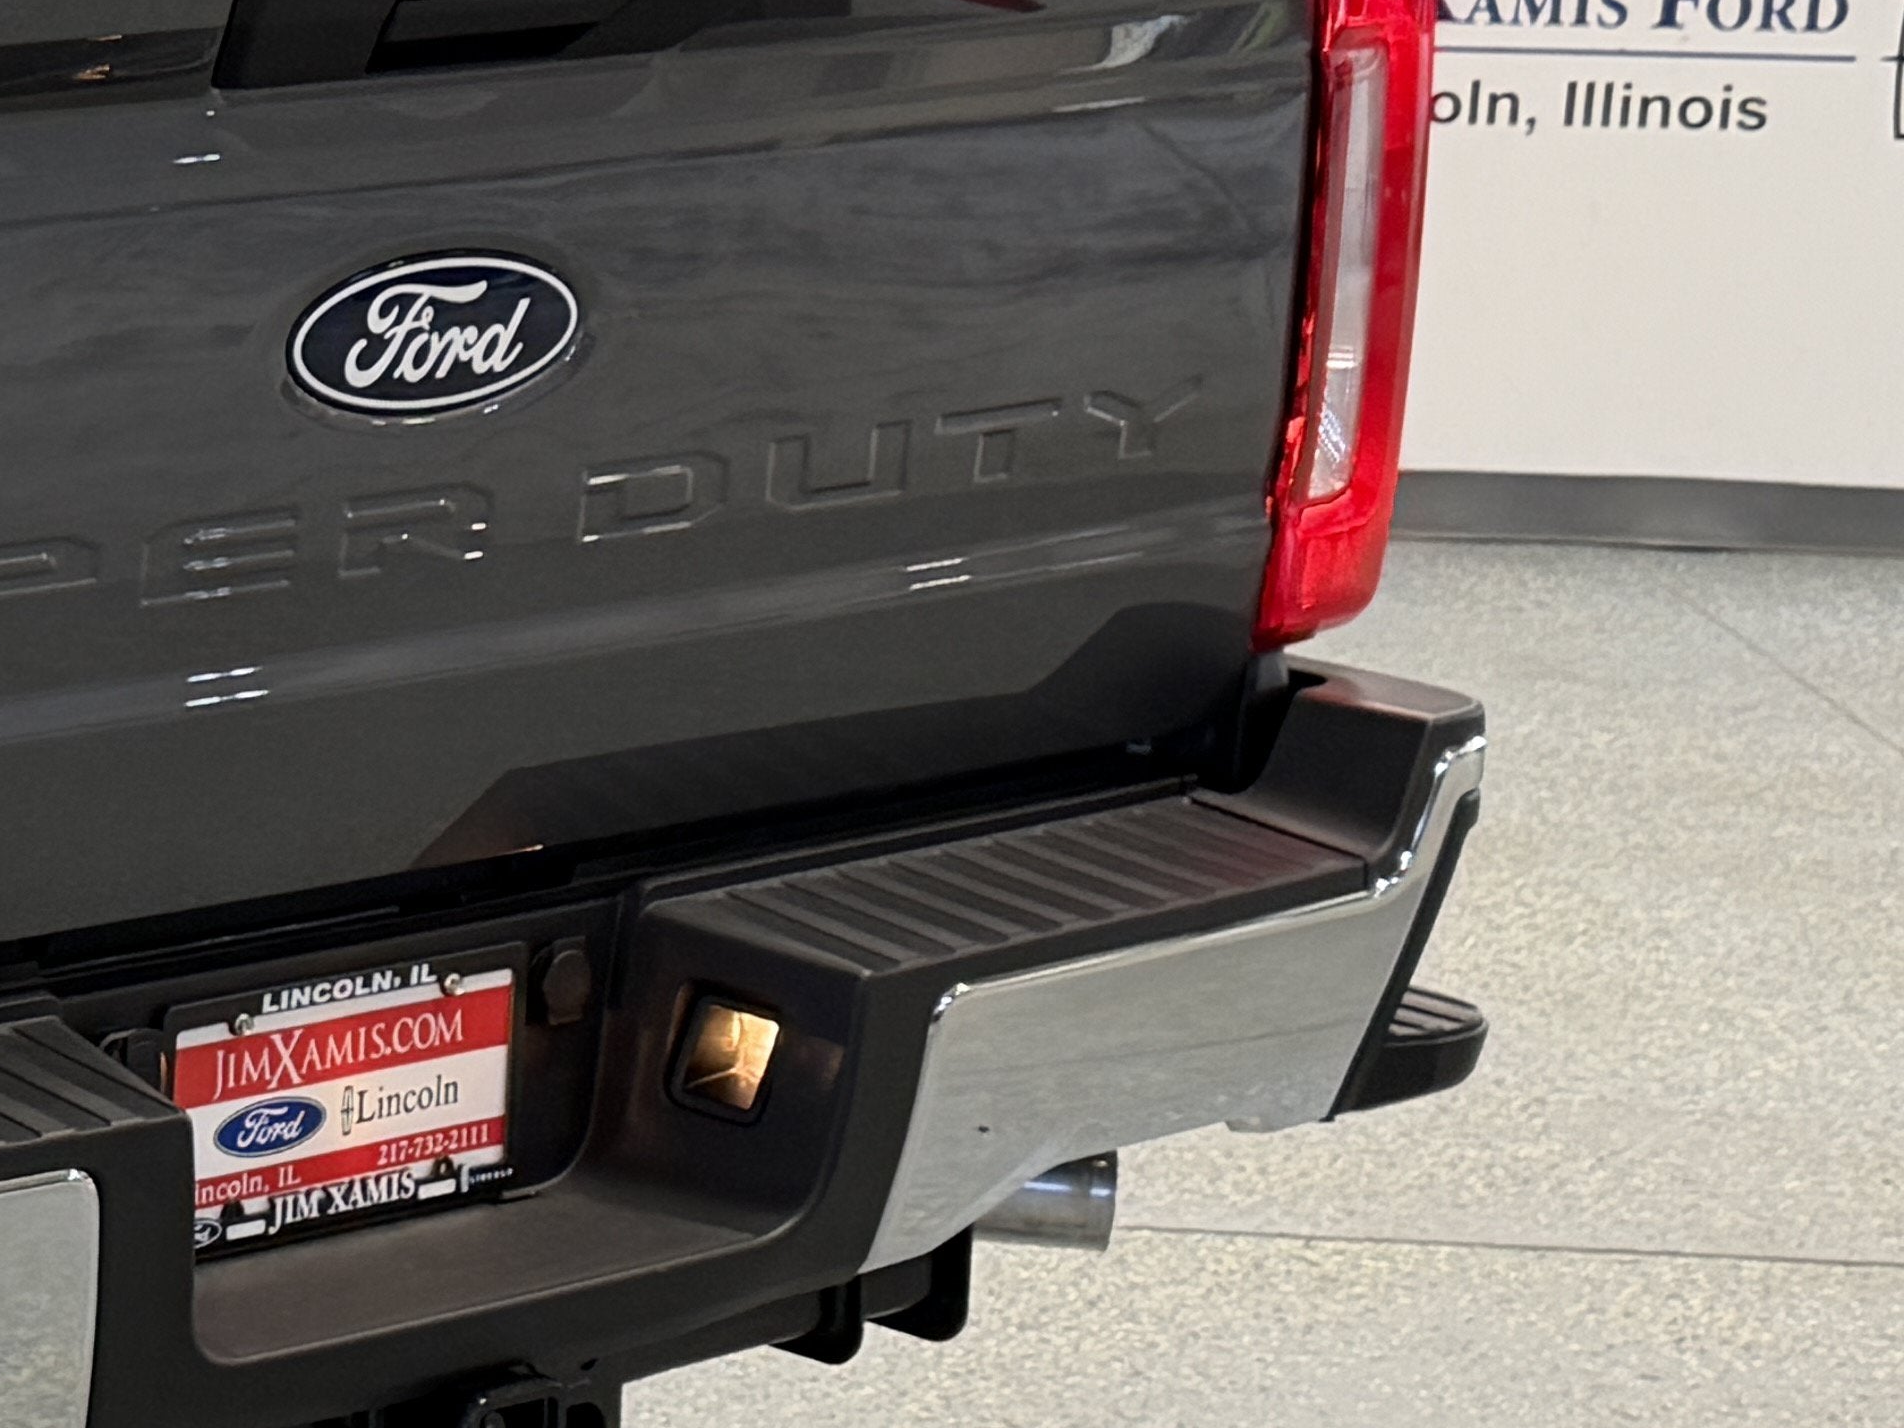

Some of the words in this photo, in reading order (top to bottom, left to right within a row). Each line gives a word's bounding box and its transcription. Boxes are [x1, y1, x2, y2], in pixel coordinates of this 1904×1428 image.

[1430, 79, 1537, 135] oln,
[1563, 81, 1769, 131] Illinois
[344, 280, 531, 388] Ford
[577, 374, 1205, 542] DUTY
[409, 962, 438, 986] IL
[356, 1075, 459, 1124] Lincoln
[237, 1106, 306, 1149] Ford
[377, 1124, 489, 1166] 217-732-2111
[277, 1165, 302, 1189] IL
[268, 1189, 320, 1236] JIM
[327, 1170, 416, 1215] XAMIS
